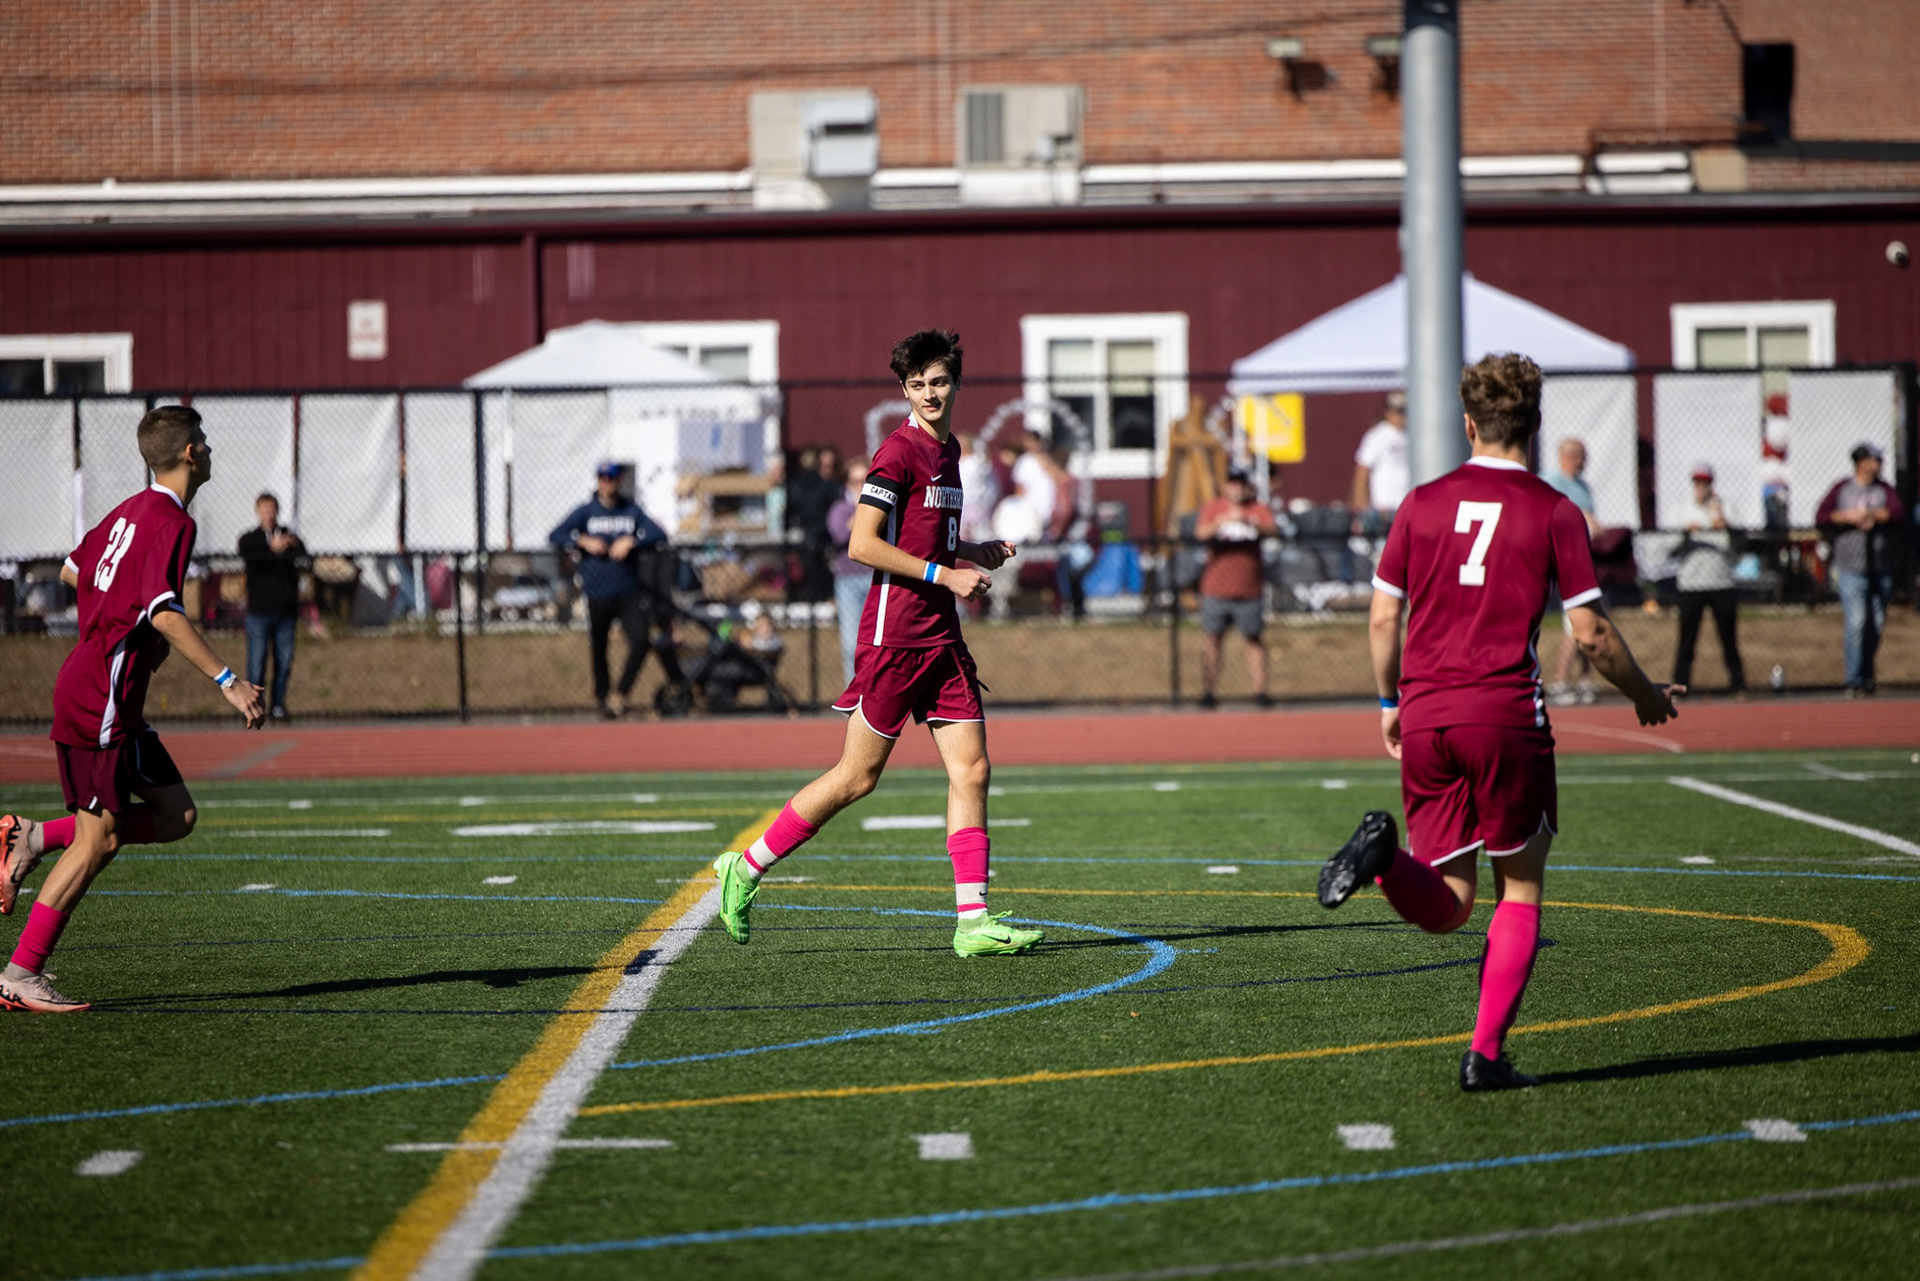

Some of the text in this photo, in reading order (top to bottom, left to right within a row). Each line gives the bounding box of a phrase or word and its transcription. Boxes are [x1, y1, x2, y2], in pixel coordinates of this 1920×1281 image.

[93, 516, 137, 593] 23
[947, 516, 957, 552] 8
[1454, 500, 1503, 587] 7
